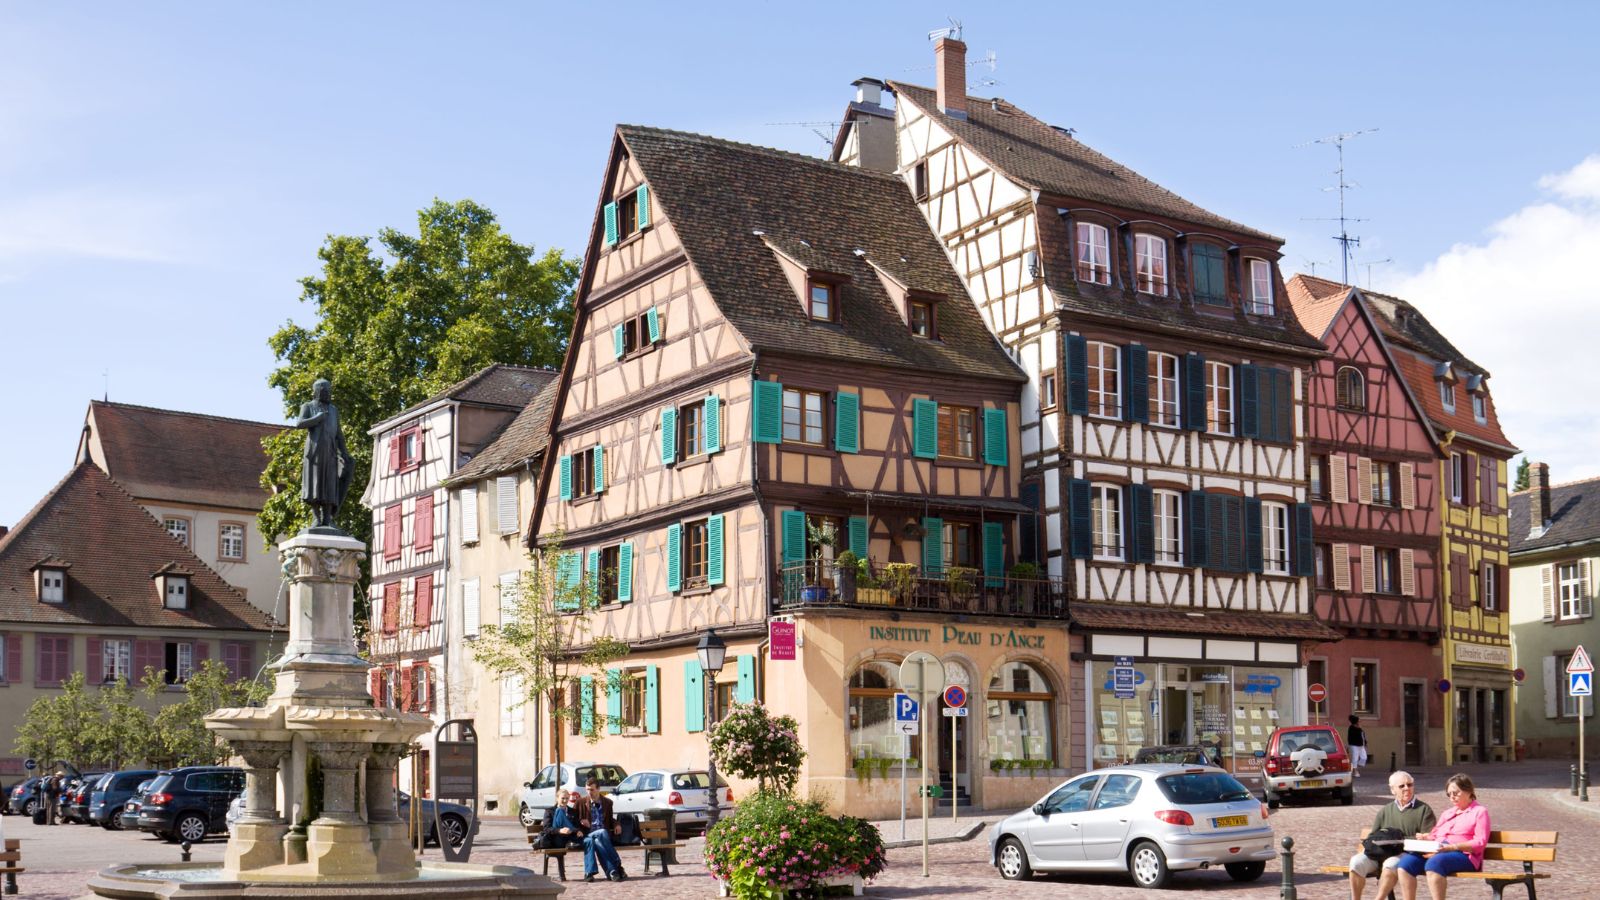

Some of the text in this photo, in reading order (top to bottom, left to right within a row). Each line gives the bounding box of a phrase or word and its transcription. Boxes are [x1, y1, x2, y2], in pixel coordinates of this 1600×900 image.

[870, 625, 1045, 649] INSTITUT PEAU D'ANGE
